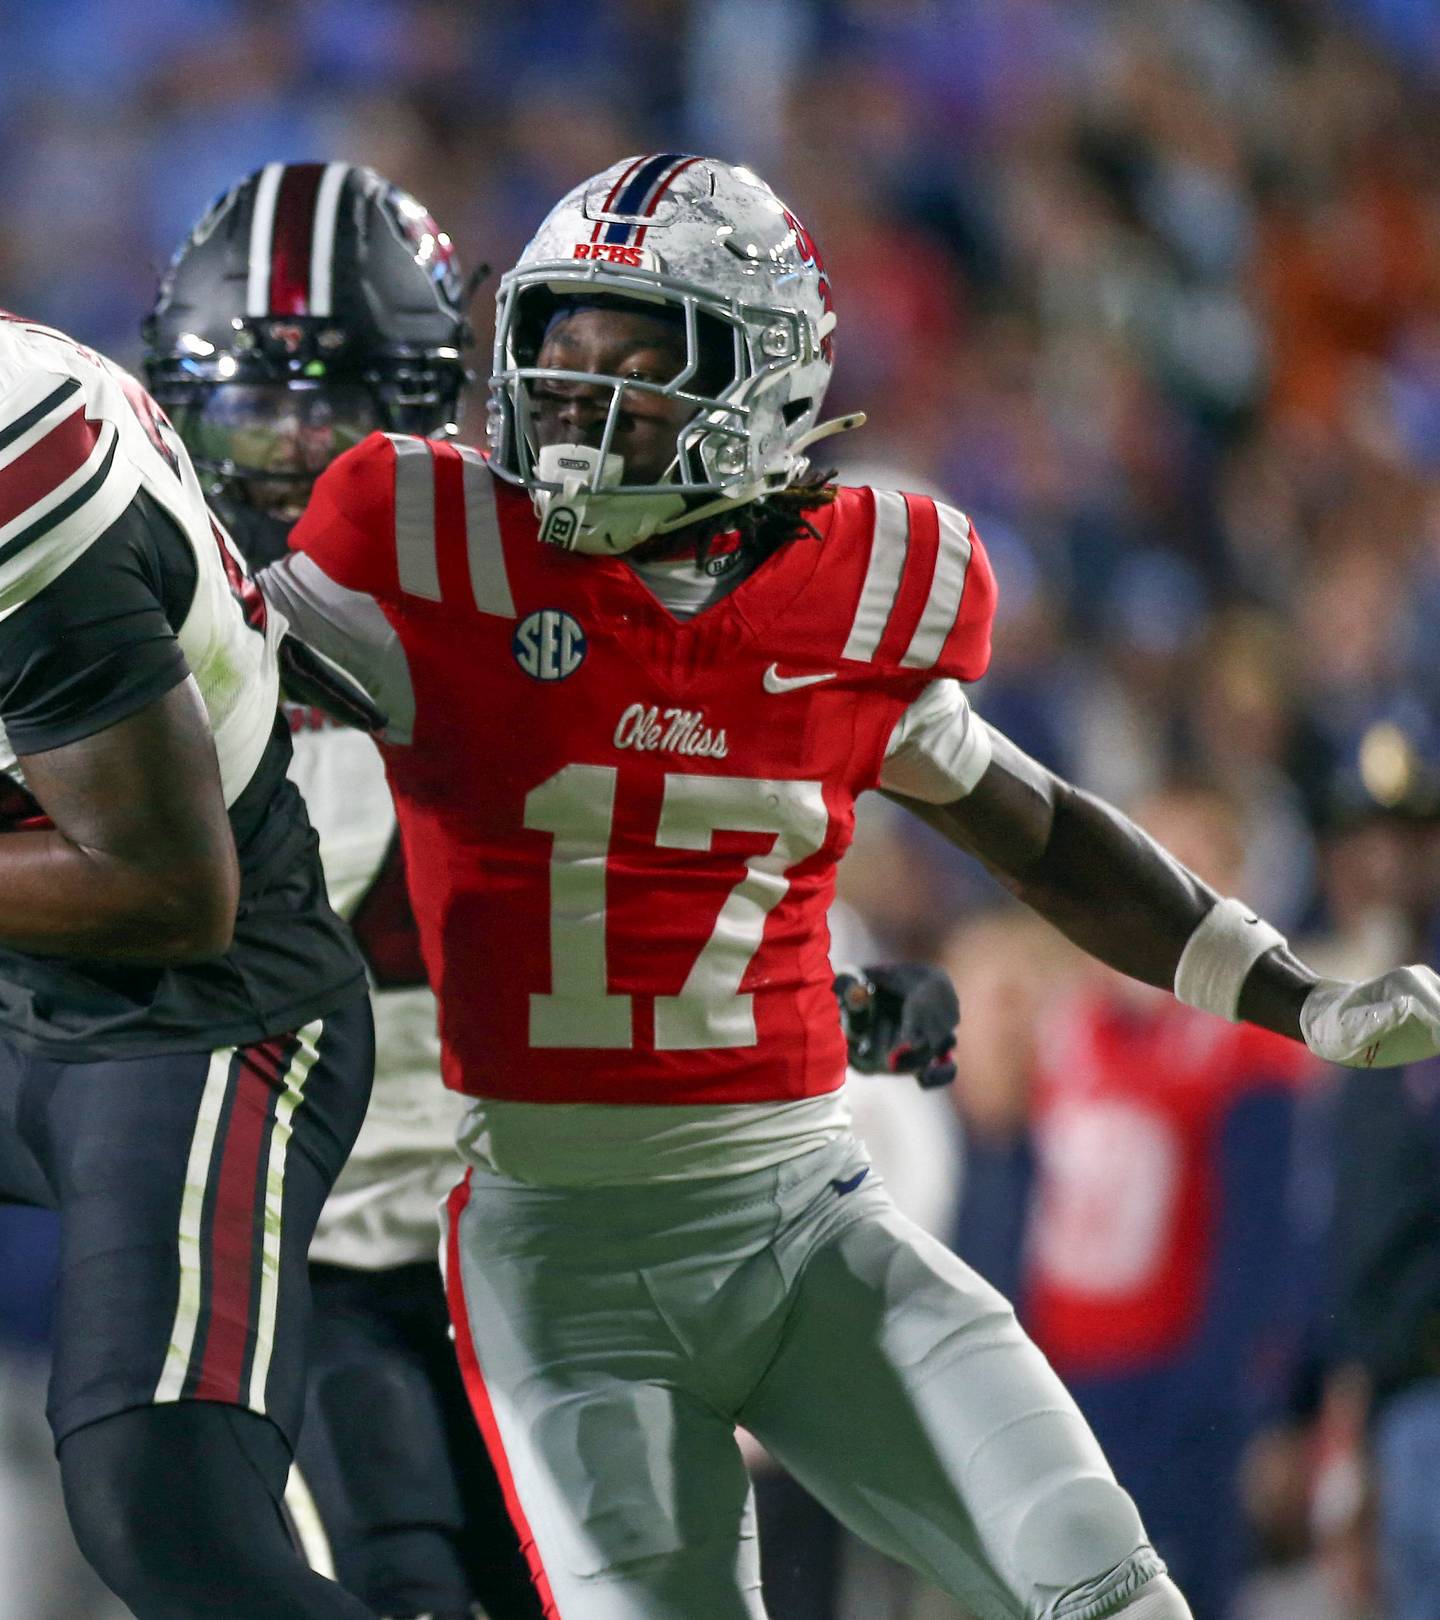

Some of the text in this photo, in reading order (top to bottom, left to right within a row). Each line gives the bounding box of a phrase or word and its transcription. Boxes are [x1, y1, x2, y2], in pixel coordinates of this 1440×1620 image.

[573, 243, 645, 268] REBS
[516, 609, 584, 679] SEC
[613, 703, 729, 759] Ole Miss
[523, 763, 828, 1051] 17
